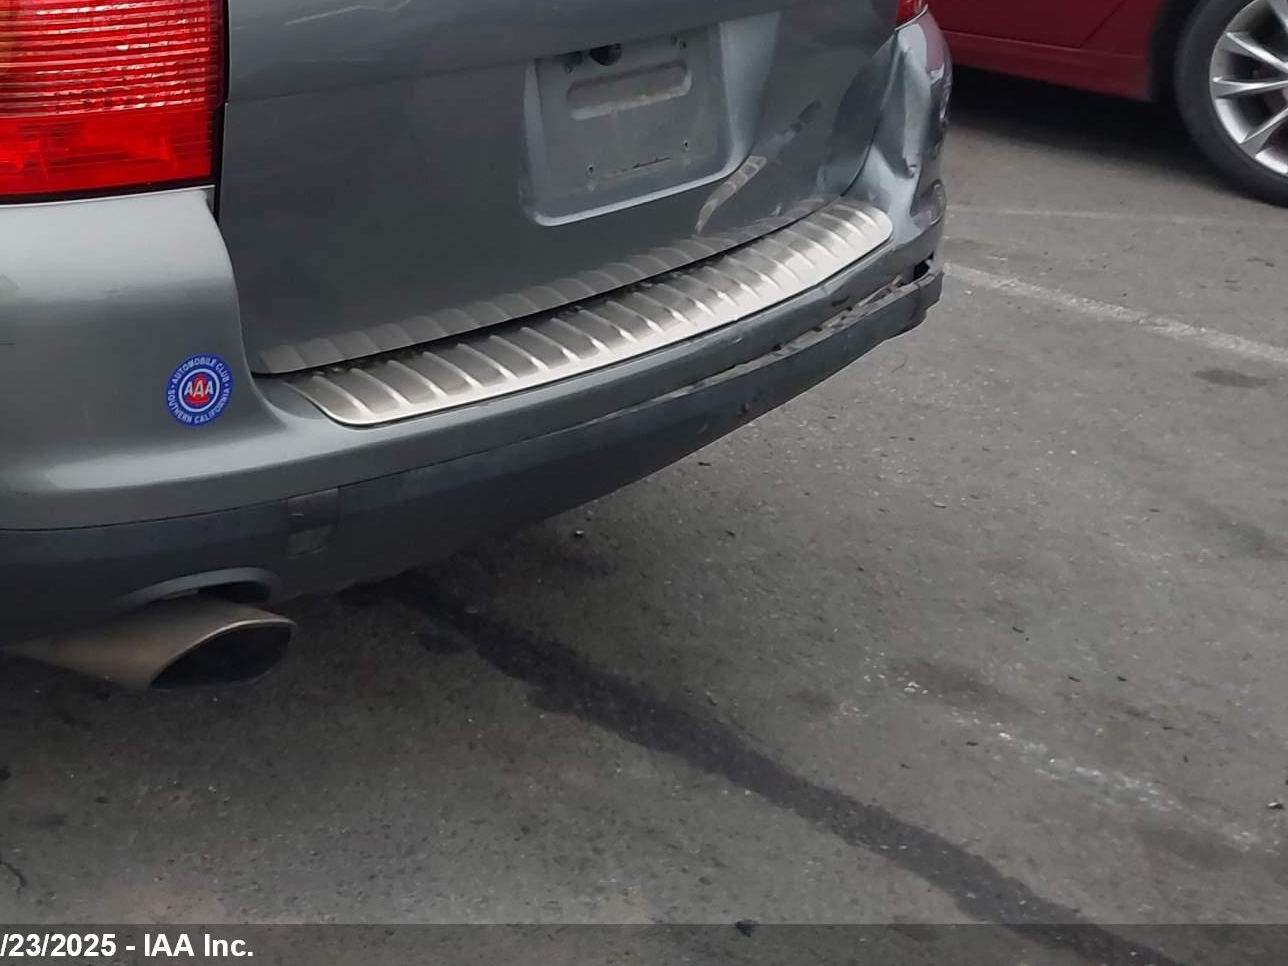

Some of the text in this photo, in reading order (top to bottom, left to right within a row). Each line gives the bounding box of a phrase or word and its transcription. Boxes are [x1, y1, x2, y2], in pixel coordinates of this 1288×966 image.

[171, 357, 230, 384] AUTOMOBILE CLUB
[184, 380, 214, 398] AAA
[167, 388, 193, 423] SOUTHERN
